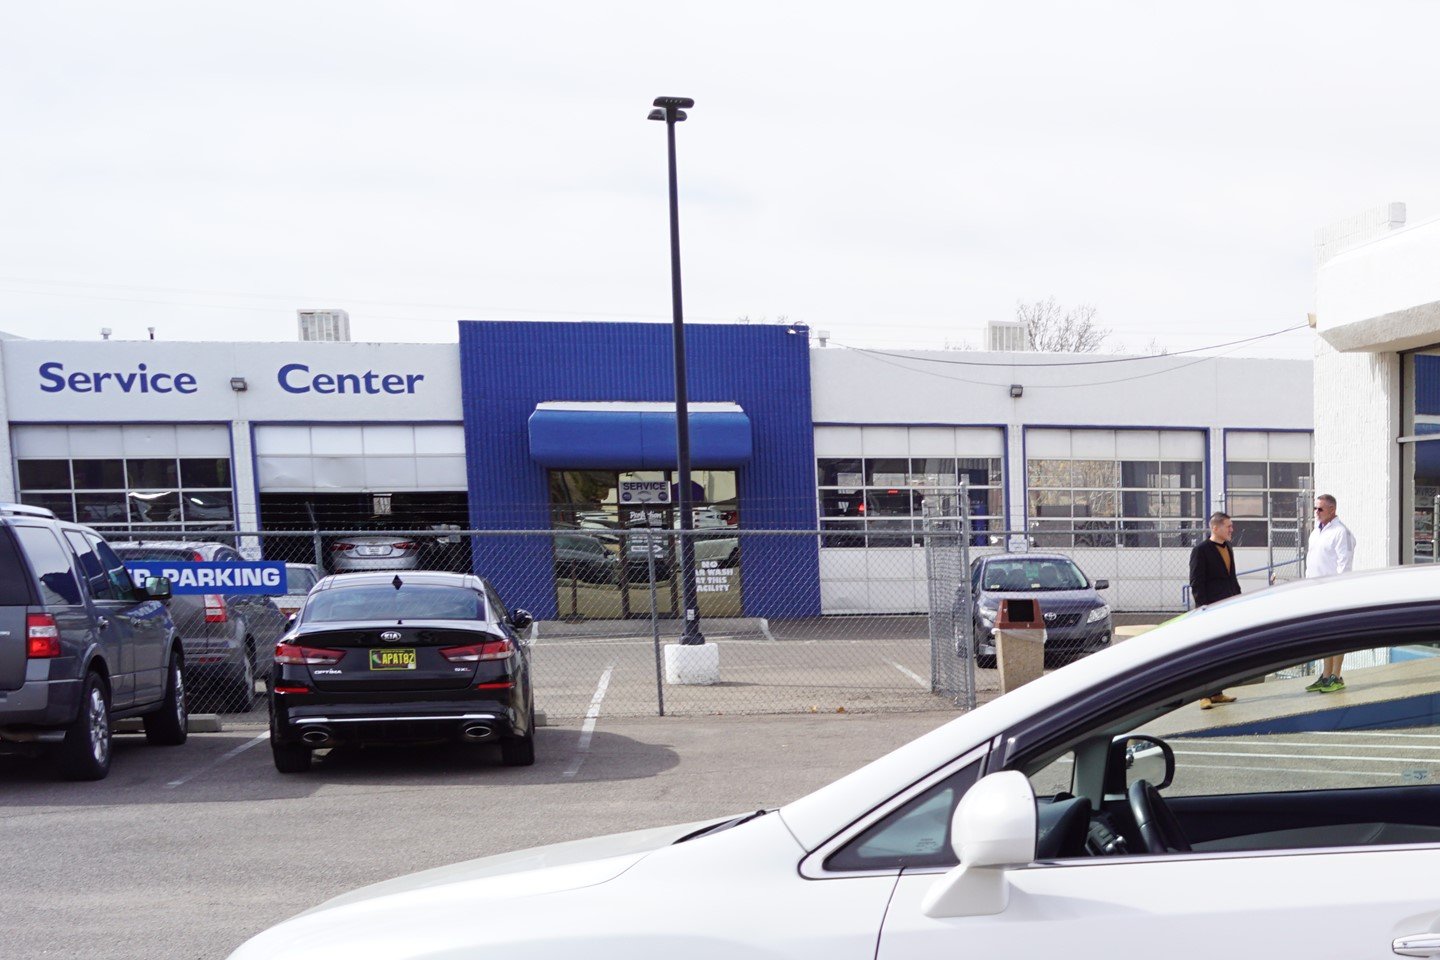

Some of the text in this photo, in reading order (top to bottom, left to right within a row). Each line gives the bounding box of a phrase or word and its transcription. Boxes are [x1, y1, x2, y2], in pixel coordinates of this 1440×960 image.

[38, 362, 424, 395] Service Center
[622, 481, 667, 491] SERVICE
[701, 561, 718, 569] NO
[162, 567, 281, 587] PARKING
[707, 568, 734, 576] WASH
